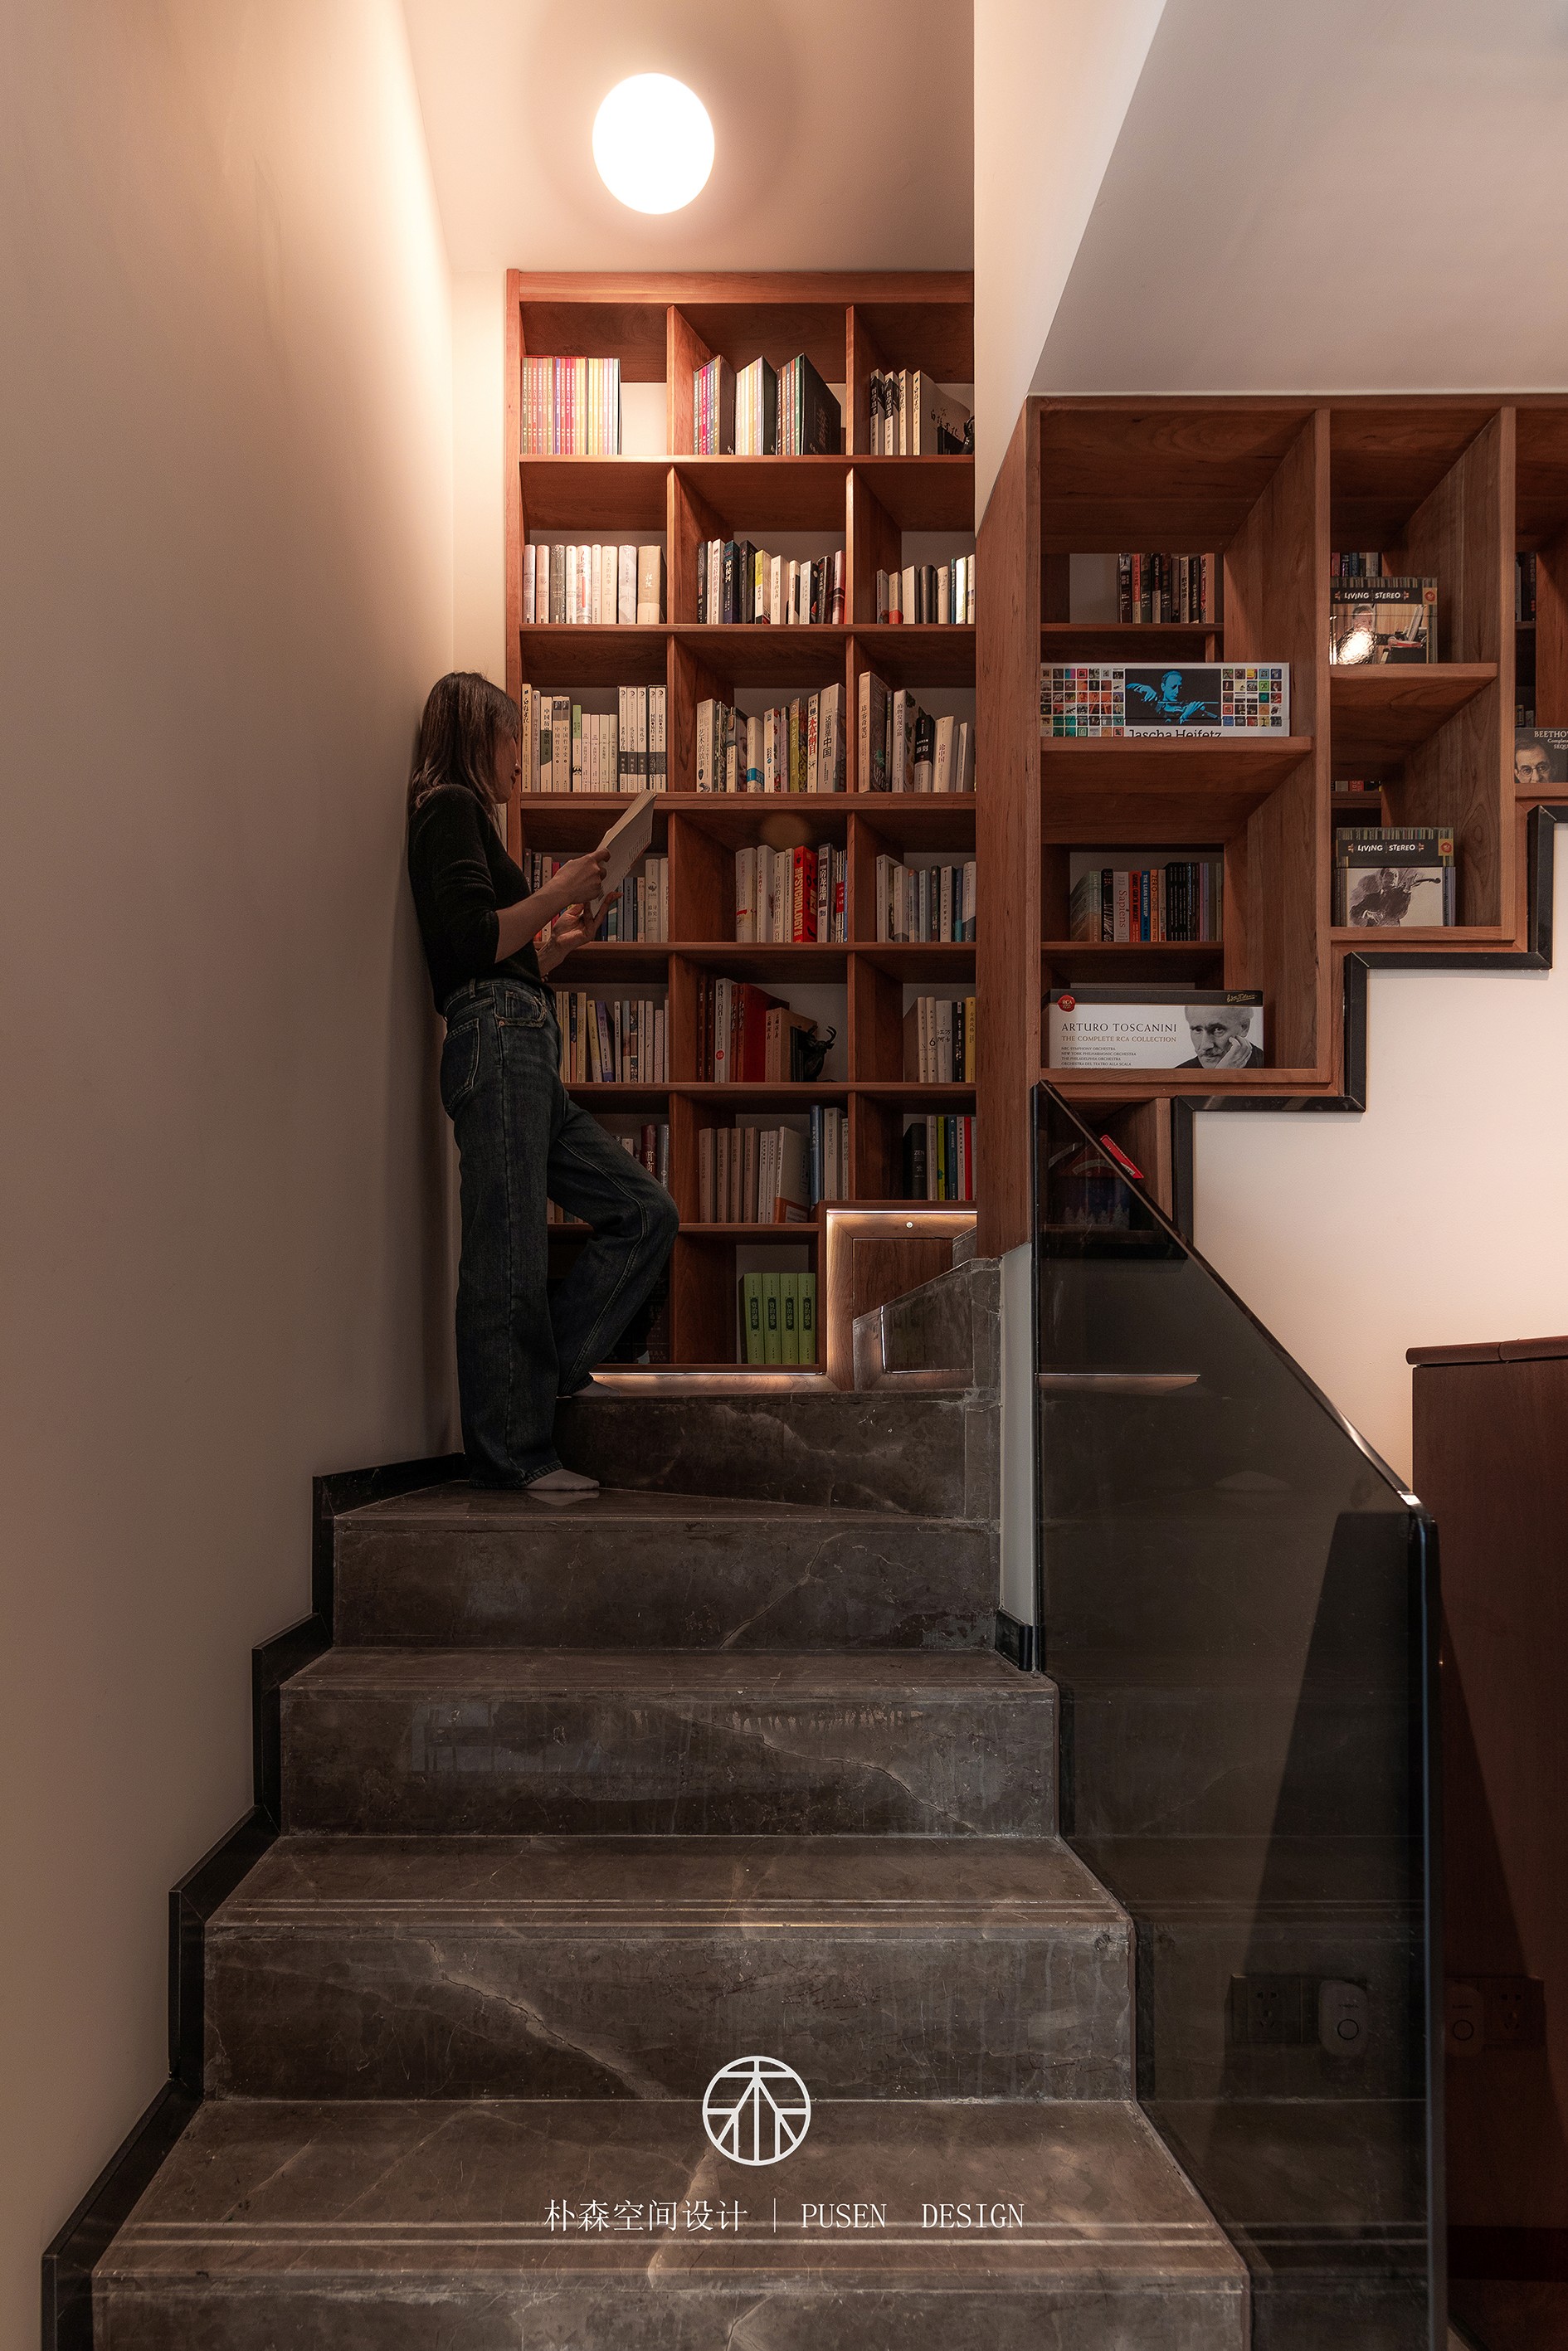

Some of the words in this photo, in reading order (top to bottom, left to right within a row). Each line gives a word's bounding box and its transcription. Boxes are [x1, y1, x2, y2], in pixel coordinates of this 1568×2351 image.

[1534, 730, 1568, 738] BEETHO
[1388, 844, 1415, 852] STEREO
[795, 872, 804, 929] PSYCHOLOGY
[1117, 890, 1127, 927] Sapiens
[1061, 1023, 1108, 1032] ARTURO
[1113, 1023, 1177, 1032] TOSCANINI
